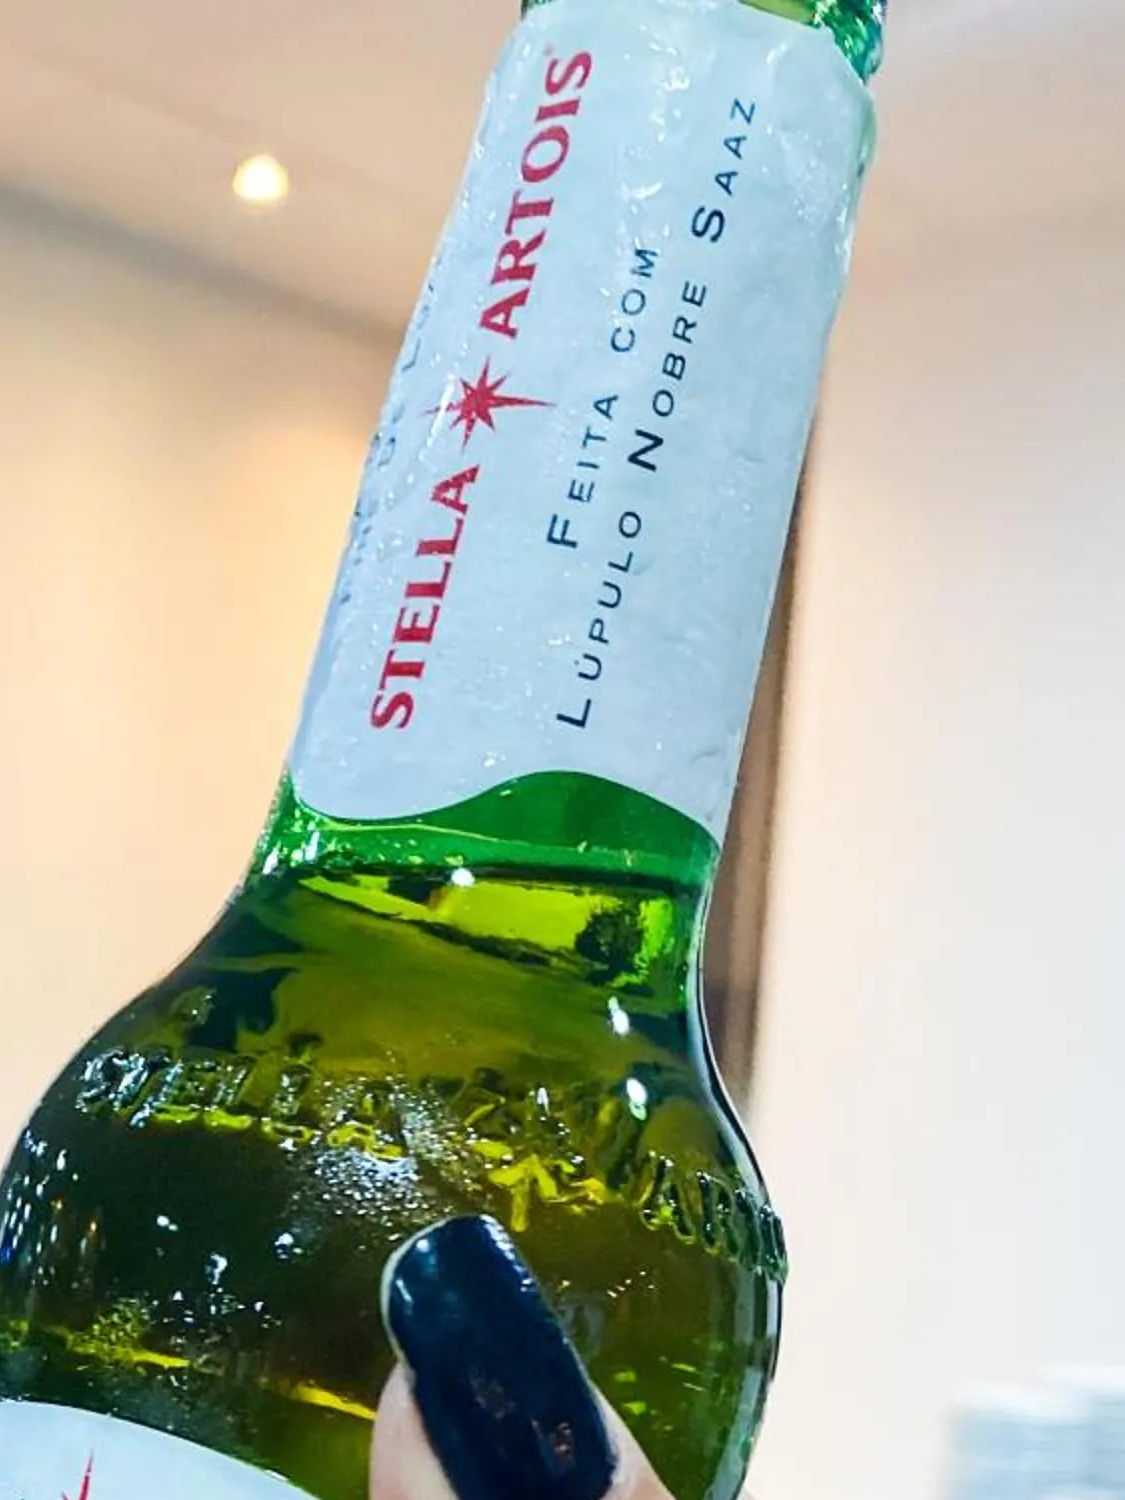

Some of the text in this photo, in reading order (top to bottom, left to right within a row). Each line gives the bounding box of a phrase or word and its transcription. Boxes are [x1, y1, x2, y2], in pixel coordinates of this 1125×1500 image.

[370, 464, 480, 729] STELLA
[481, 48, 592, 339] ARTOIS
[546, 248, 657, 549] FEITA COM
[627, 281, 707, 472] NOBRE
[691, 98, 756, 243] SAAZ
